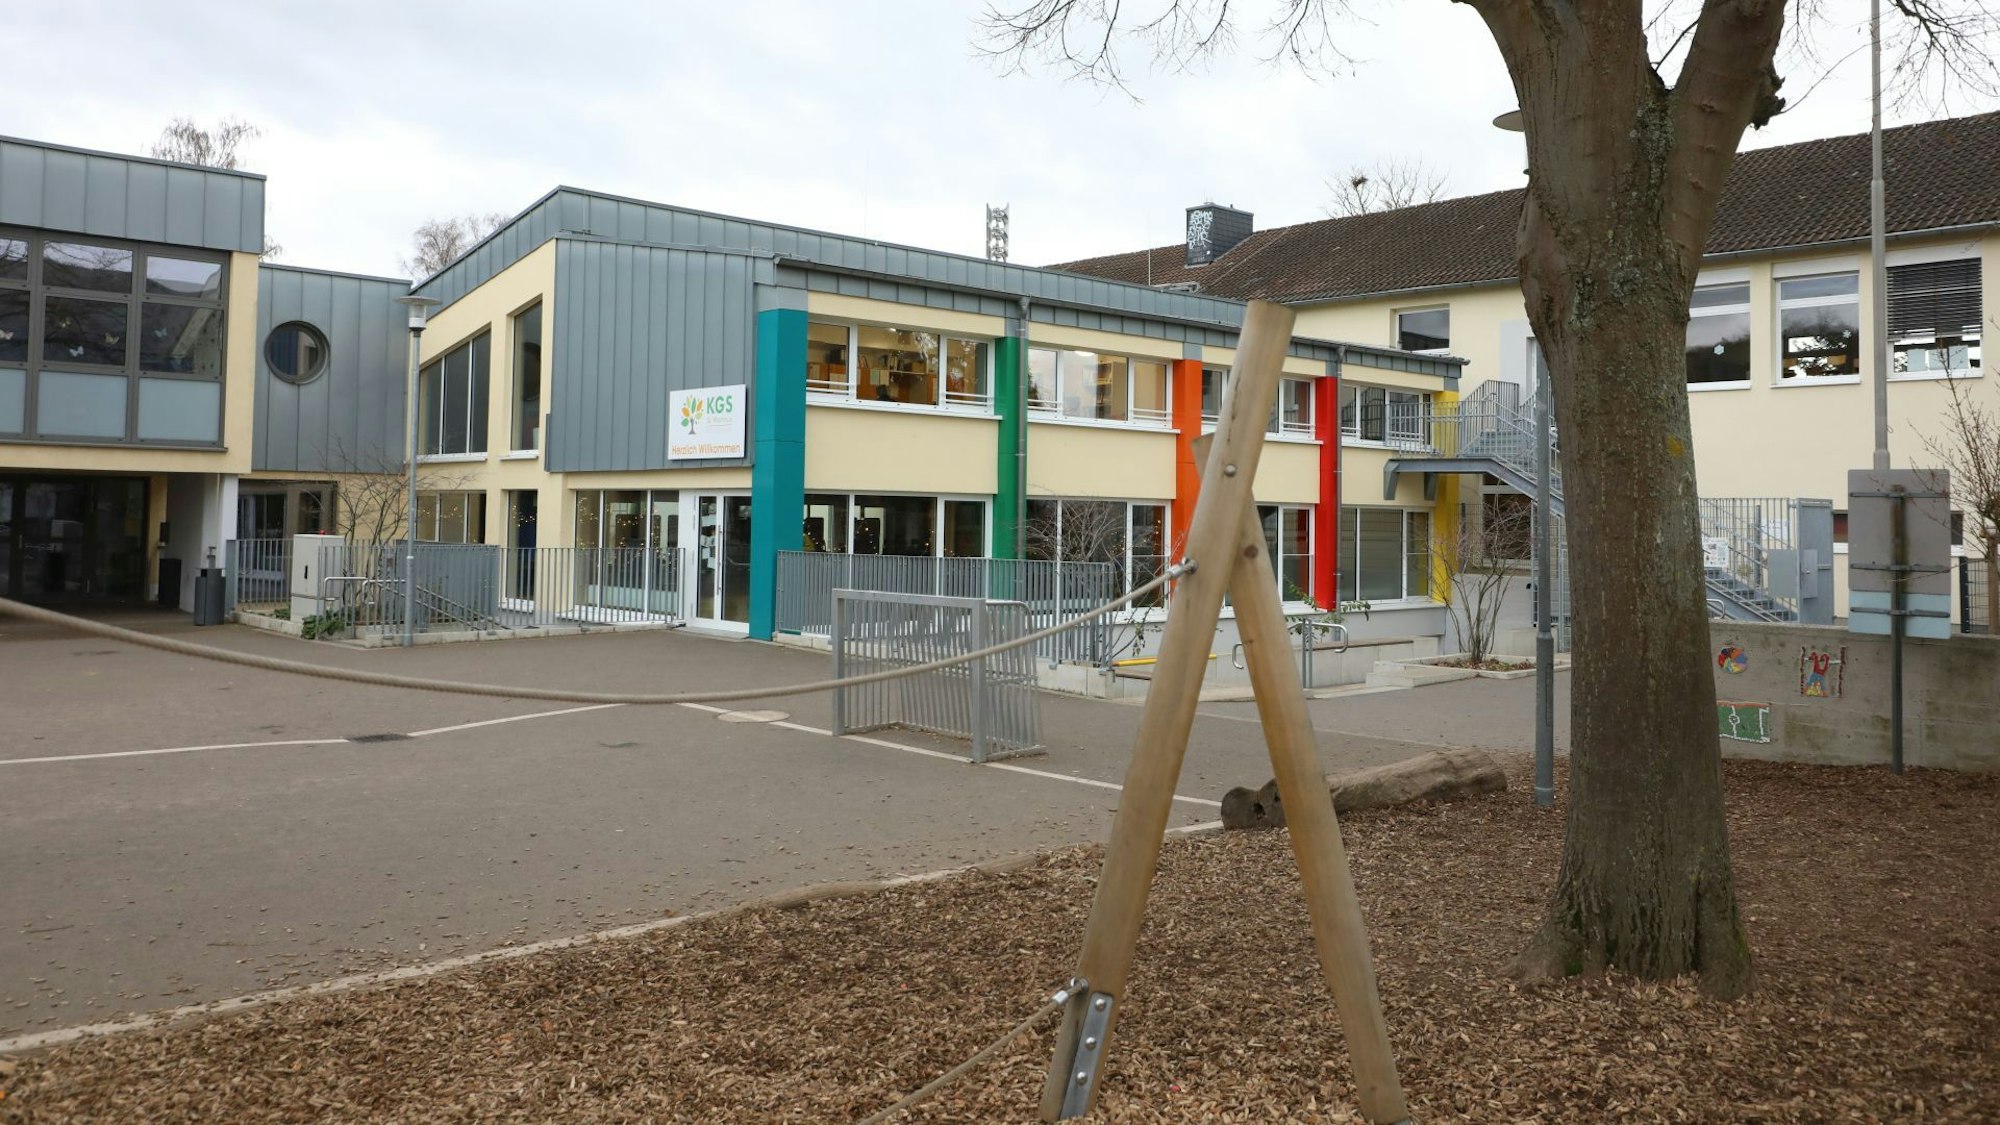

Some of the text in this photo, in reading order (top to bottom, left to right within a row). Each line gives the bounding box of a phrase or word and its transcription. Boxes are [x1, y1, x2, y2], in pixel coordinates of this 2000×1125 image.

[707, 395, 733, 414] KGS
[672, 444, 740, 455] Herzlich Willkommen
